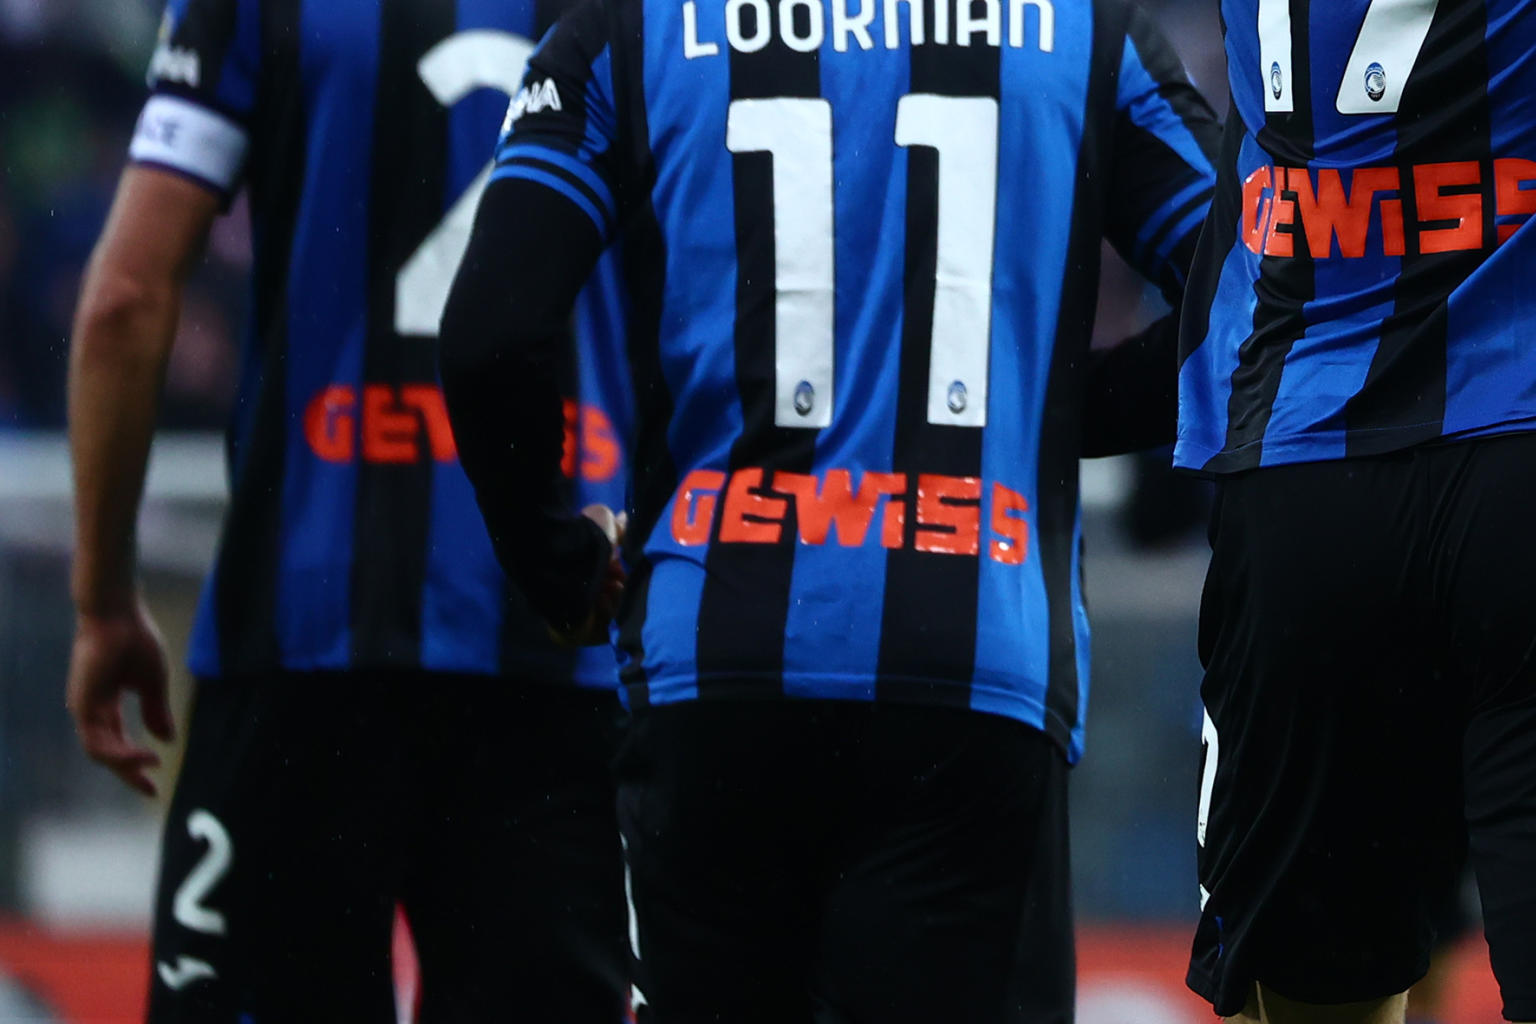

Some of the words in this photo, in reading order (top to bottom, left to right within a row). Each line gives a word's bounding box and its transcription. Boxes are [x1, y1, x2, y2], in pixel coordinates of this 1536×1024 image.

[726, 92, 1000, 429] 11
[670, 466, 1029, 566] GEWISS
[173, 807, 234, 935] 2
